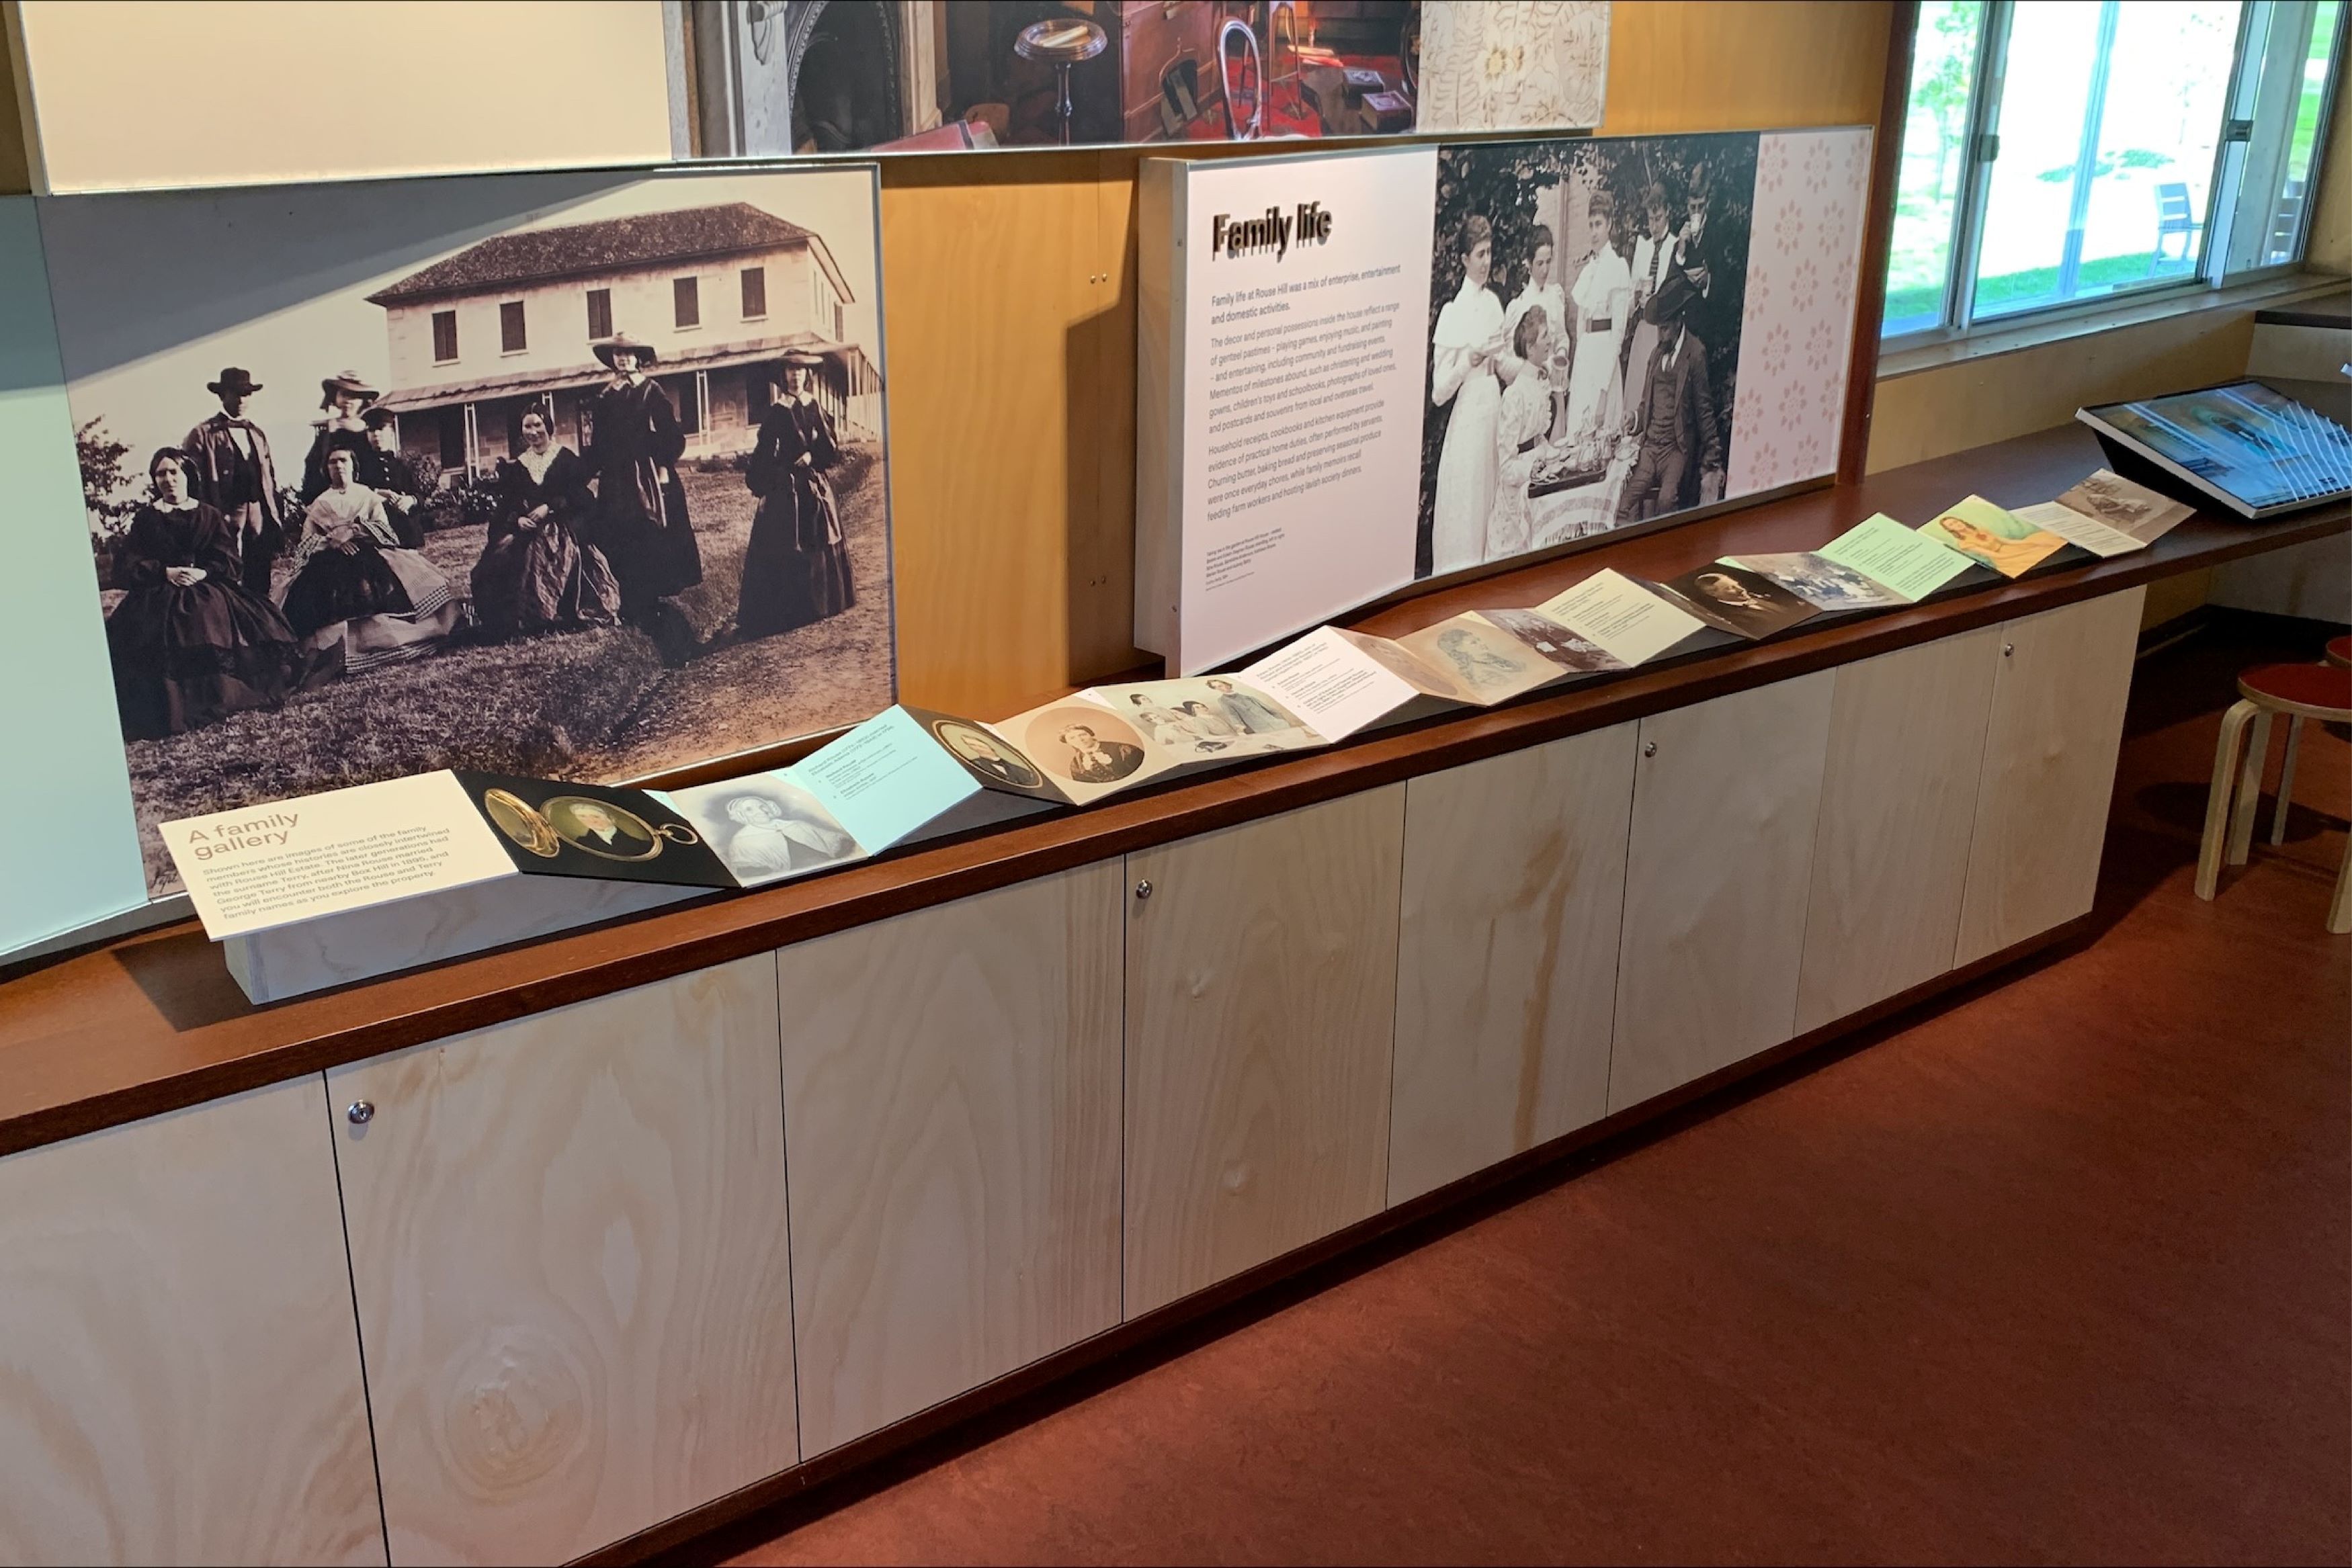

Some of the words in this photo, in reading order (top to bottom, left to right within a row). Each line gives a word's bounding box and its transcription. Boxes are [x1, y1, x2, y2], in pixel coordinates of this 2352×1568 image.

[1212, 206, 1293, 263] Family
[1296, 201, 1332, 248] life
[1212, 293, 1234, 306] Family
[1236, 291, 1246, 302] life
[1247, 290, 1254, 300] at
[1255, 288, 1275, 298] Rouse
[1277, 284, 1288, 294] Hill
[1289, 284, 1301, 292] was
[1308, 279, 1318, 288] mix
[1320, 276, 1327, 286] of
[1361, 265, 1400, 279] entertainment
[1211, 312, 1224, 324] and
[1226, 308, 1257, 320] domestic
[189, 830, 209, 844] A
[214, 813, 298, 838] family
[194, 830, 288, 861] gallery
